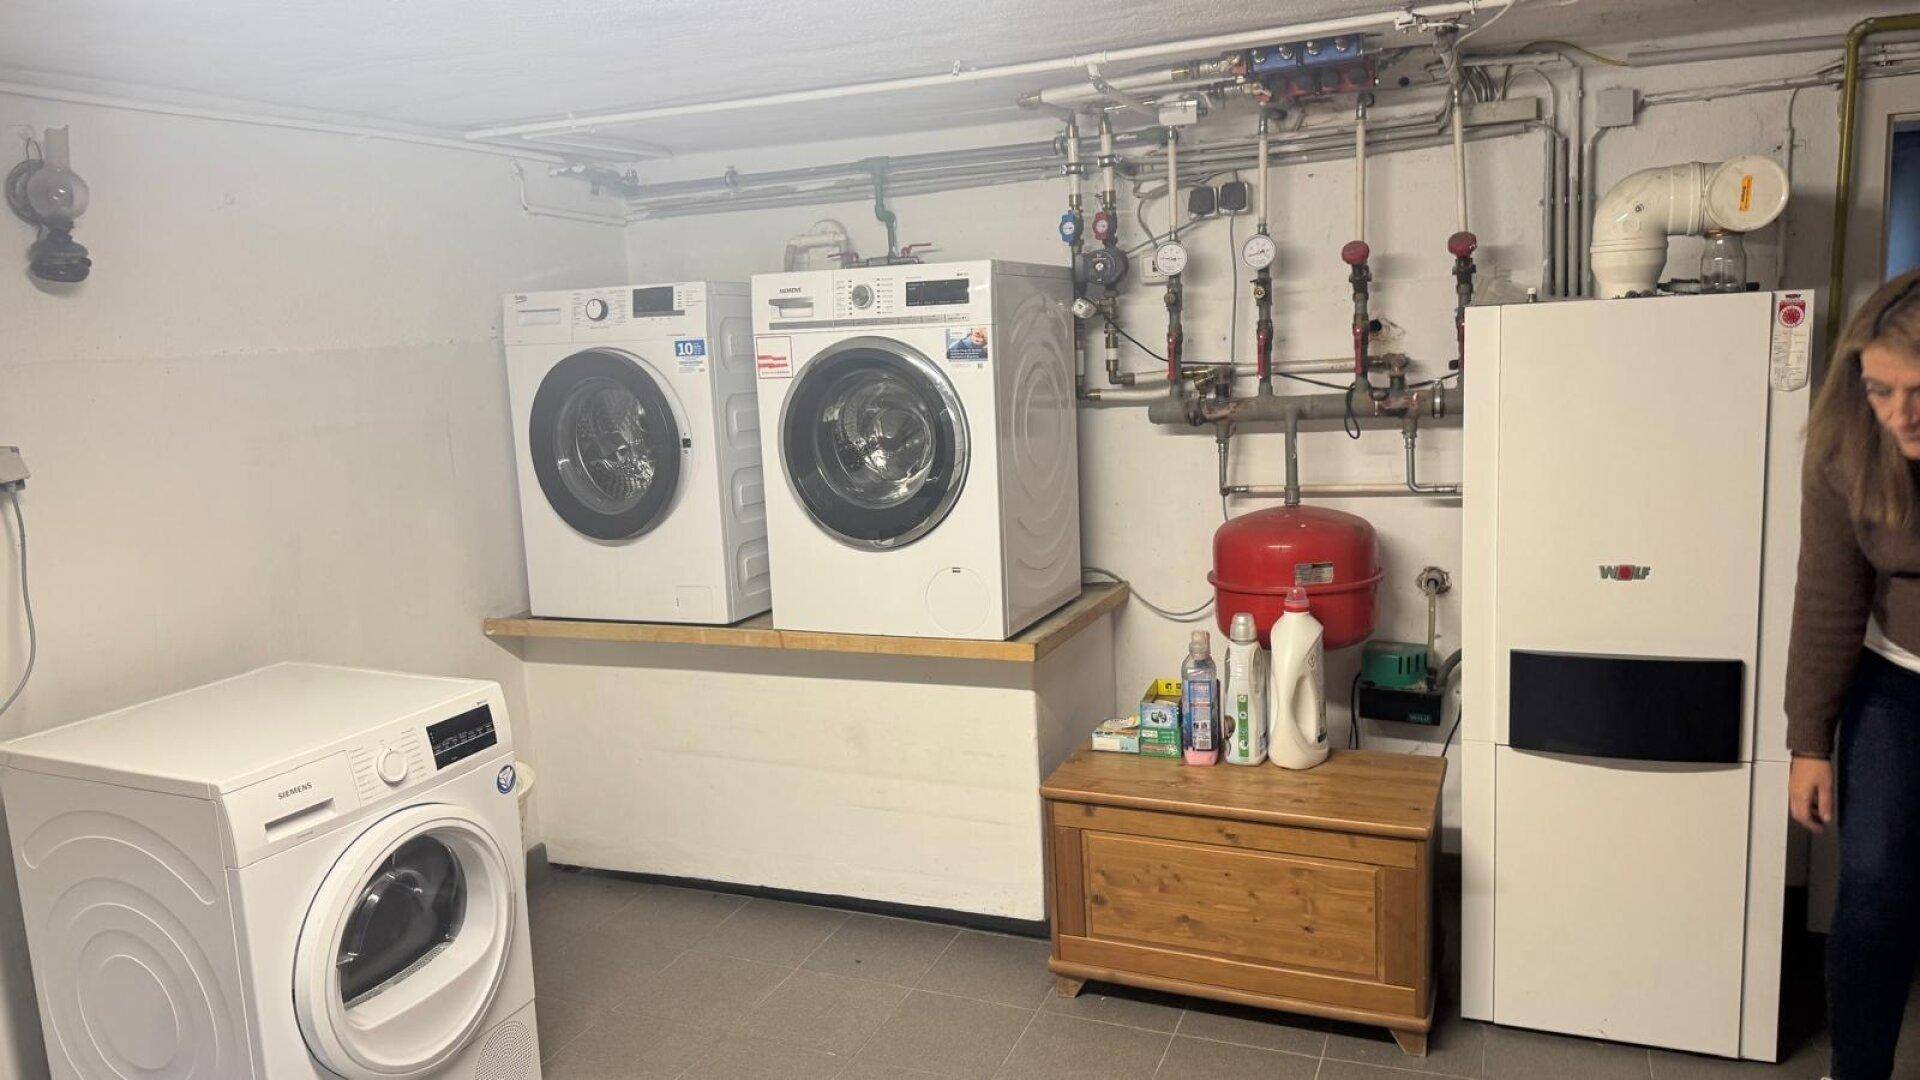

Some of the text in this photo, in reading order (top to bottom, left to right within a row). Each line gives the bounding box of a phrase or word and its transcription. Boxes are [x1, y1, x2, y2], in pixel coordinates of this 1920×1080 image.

[677, 342, 694, 355] 10
[1599, 565, 1650, 580] WOLF
[278, 782, 313, 799] SIEMENS
